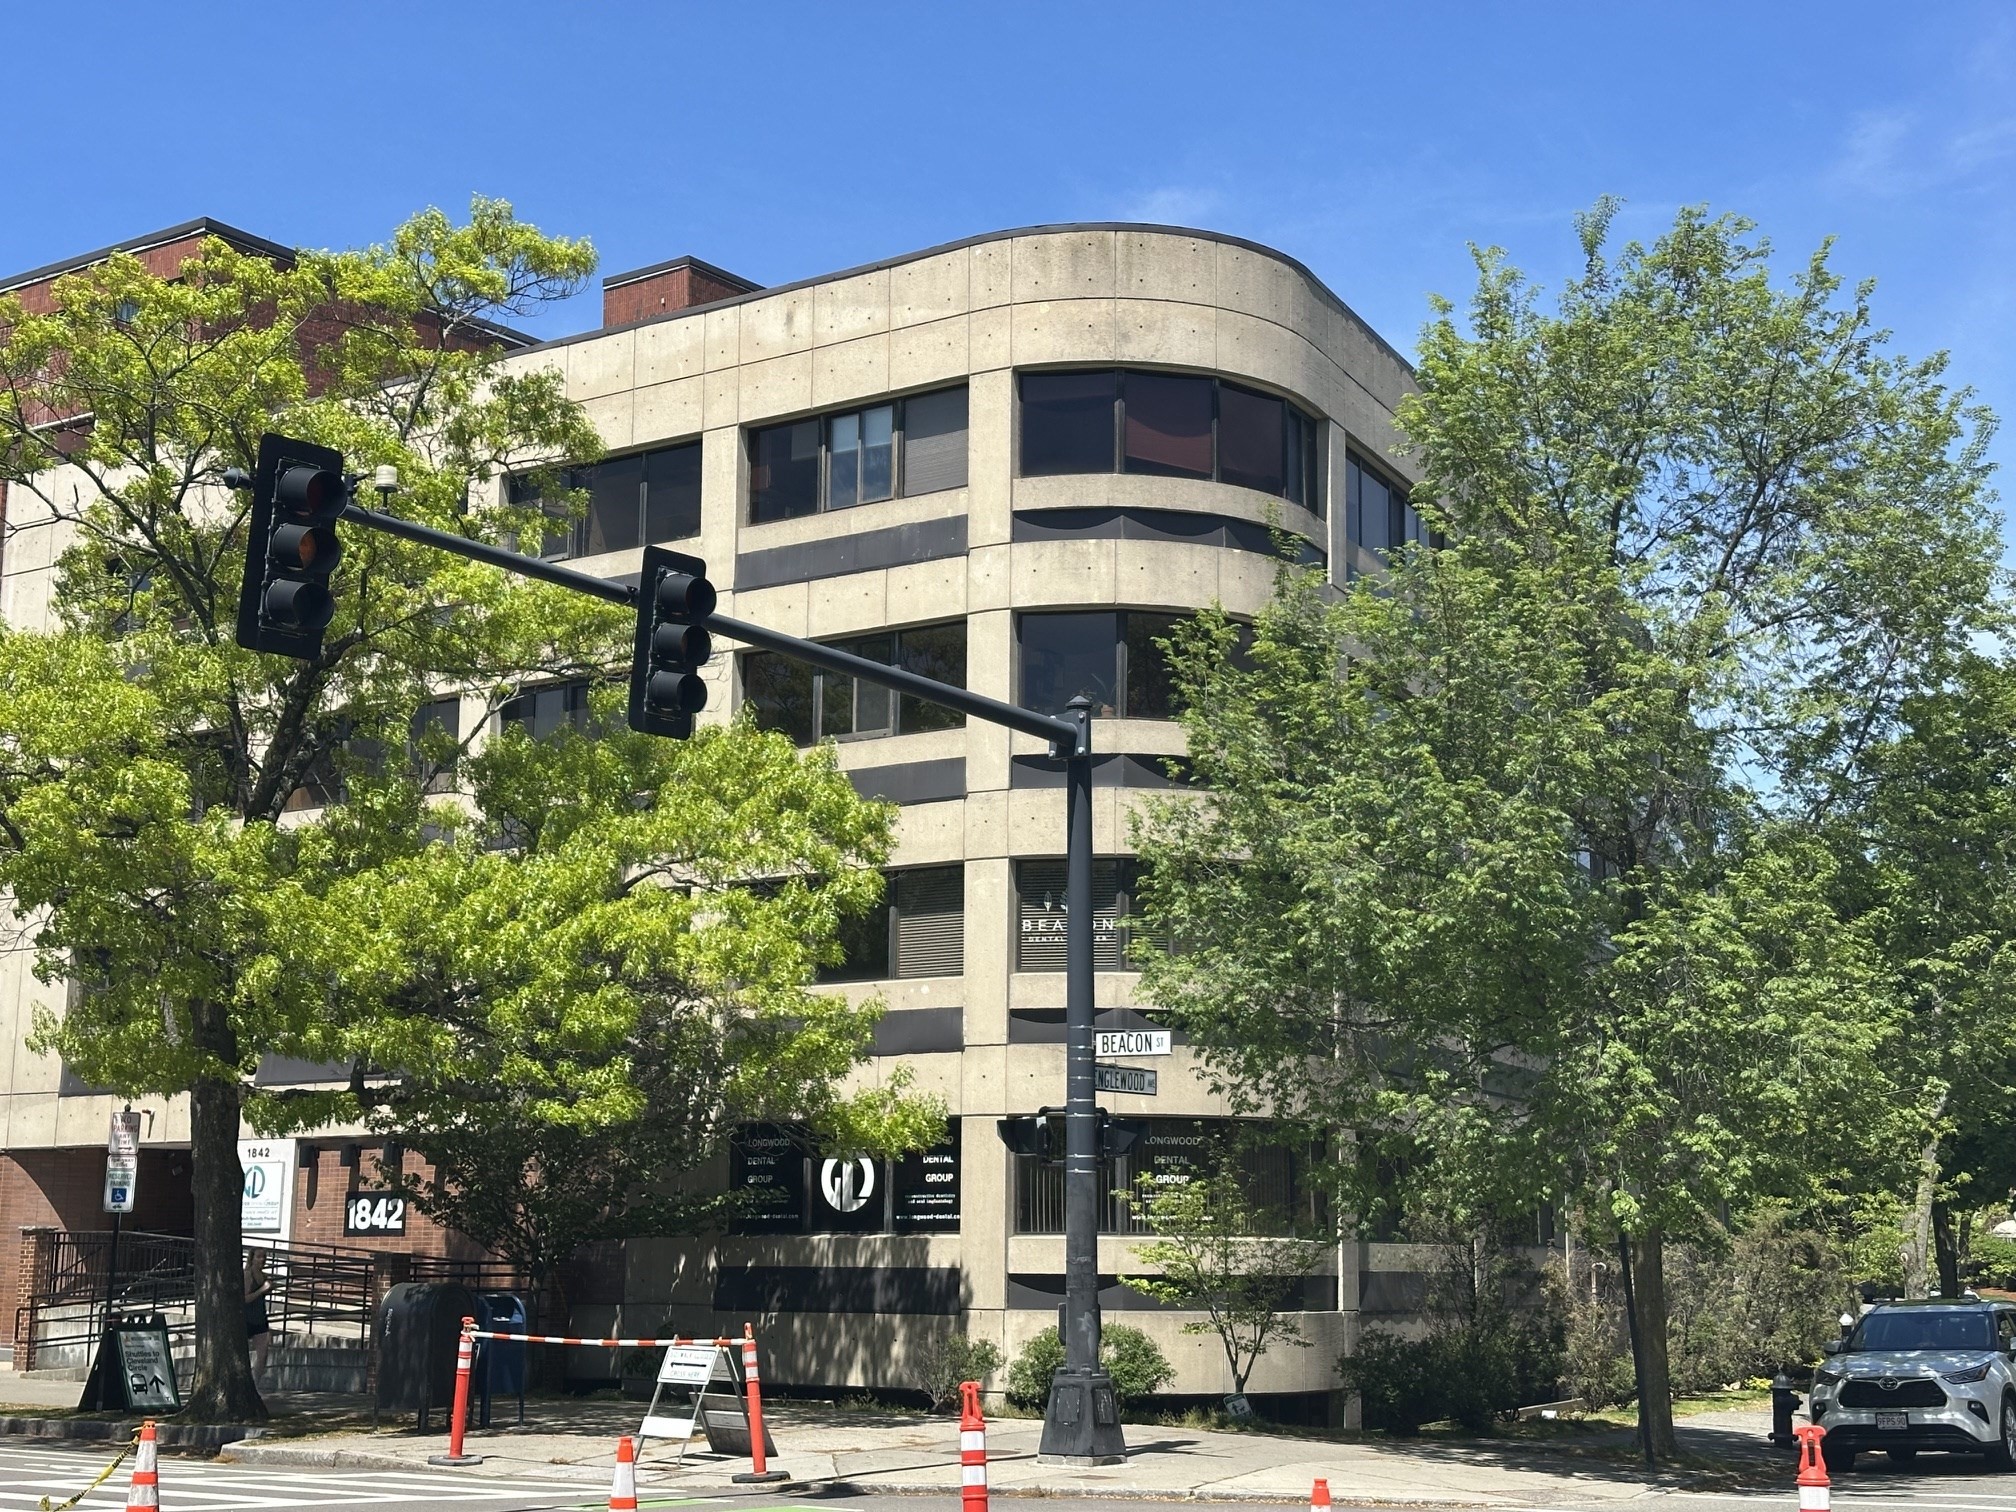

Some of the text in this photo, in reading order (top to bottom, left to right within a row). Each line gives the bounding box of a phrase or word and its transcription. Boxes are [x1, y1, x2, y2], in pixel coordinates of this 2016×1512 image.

[1022, 918, 1113, 931] BEAN
[1102, 1033, 1164, 1053] BEACON ST
[113, 1124, 138, 1133] PARKING
[748, 1138, 790, 1147] LONGWOOD
[1145, 1136, 1199, 1145] LONGWOOD
[247, 1147, 270, 1158] 1842
[747, 1156, 775, 1165] DENTAL
[922, 1155, 954, 1164] DENTAL
[1154, 1155, 1190, 1164] DENTAL
[747, 1175, 773, 1183] GROUP
[925, 1173, 954, 1182] GROUP
[1155, 1174, 1189, 1184] GROUP
[347, 1198, 404, 1230] 1842
